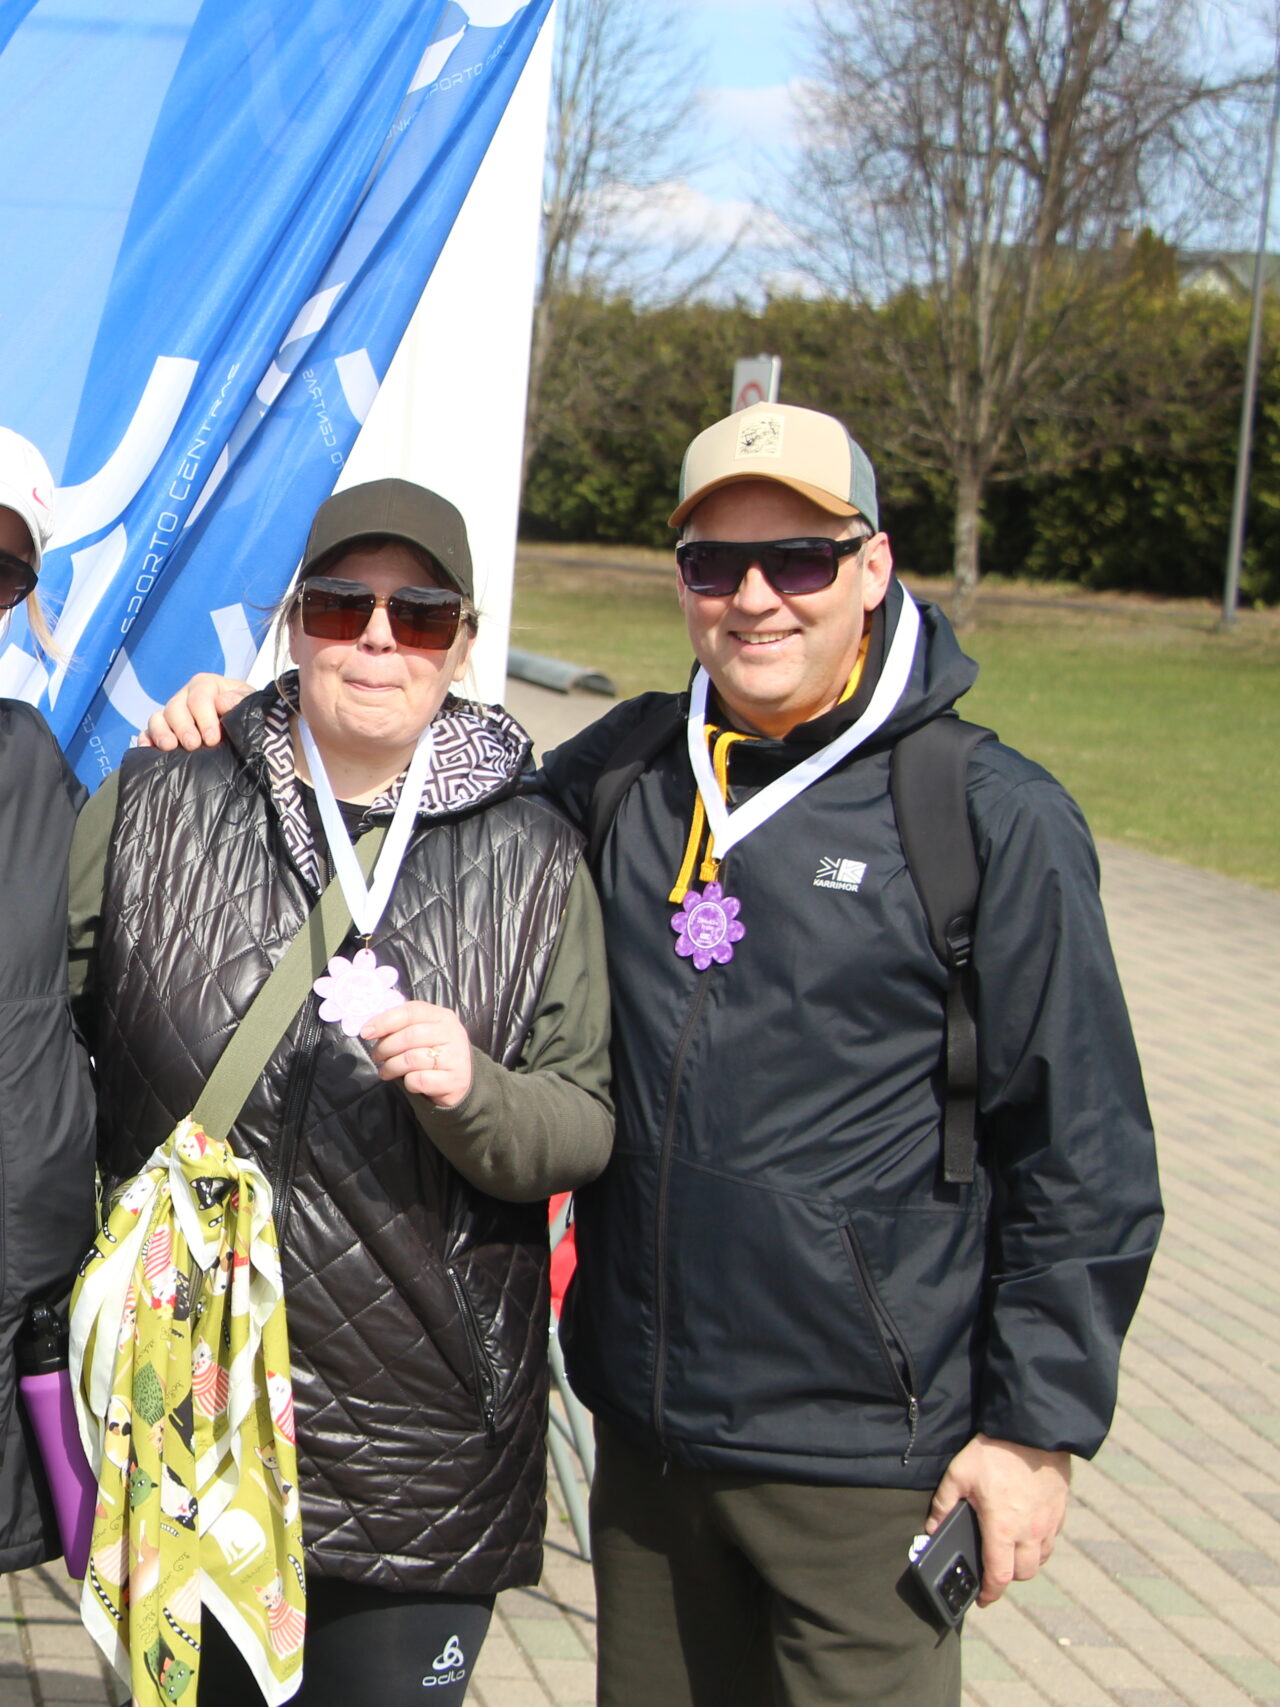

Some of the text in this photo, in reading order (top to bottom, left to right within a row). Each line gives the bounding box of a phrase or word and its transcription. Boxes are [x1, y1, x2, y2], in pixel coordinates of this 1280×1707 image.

[426, 62, 484, 100] PORTO
[120, 362, 240, 635] SPORTO CENTRAS
[812, 878, 859, 893] KARRIMOR
[422, 1669, 466, 1687] odlo
